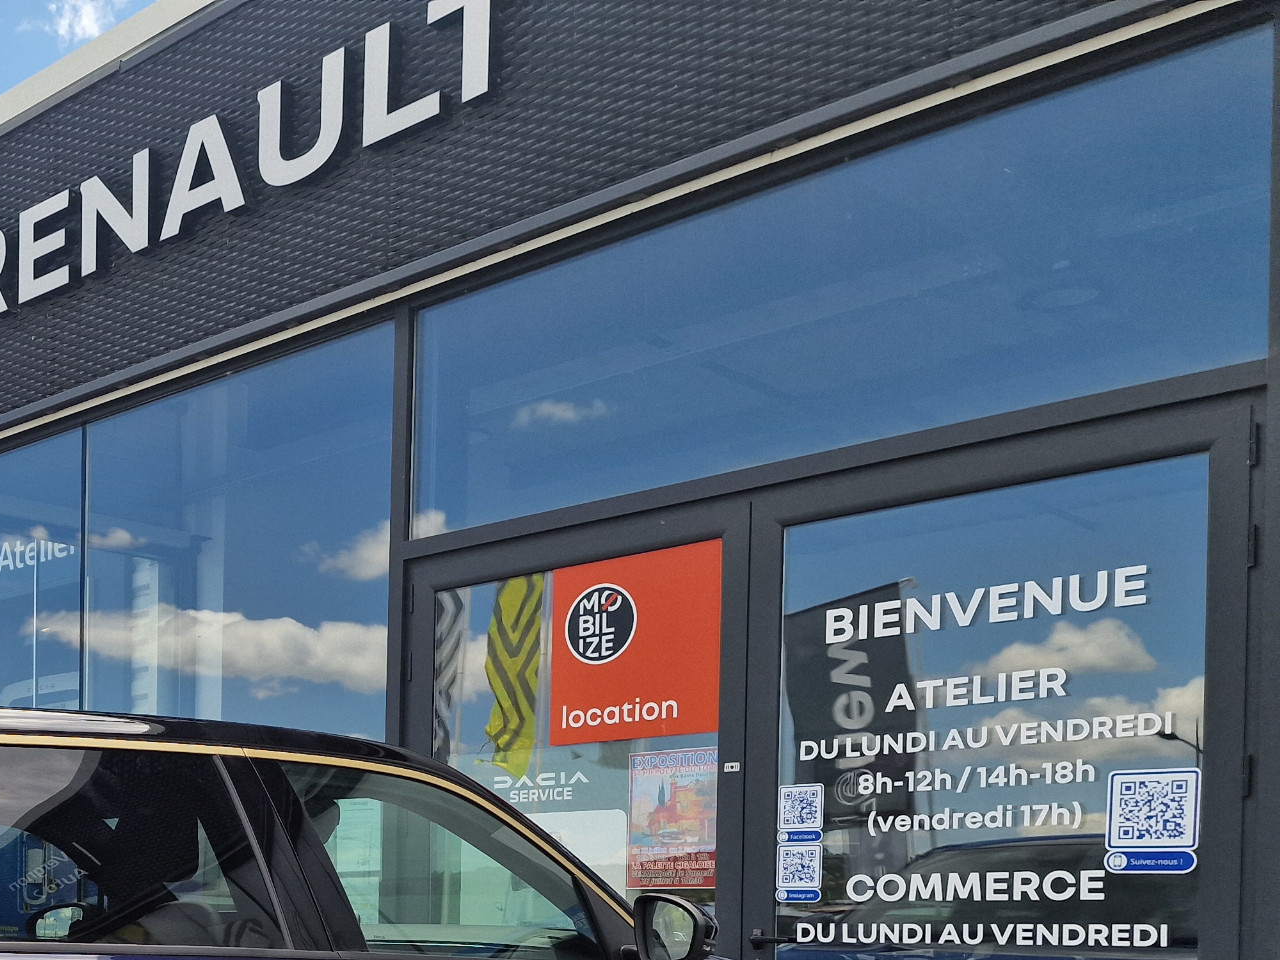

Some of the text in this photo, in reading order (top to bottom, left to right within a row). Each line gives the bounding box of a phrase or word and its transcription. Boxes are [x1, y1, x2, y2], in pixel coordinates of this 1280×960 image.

[825, 564, 1148, 645] BIENVENUE
[884, 667, 1067, 713] ATELIER
[561, 697, 678, 729] location
[799, 711, 1172, 761] DU LUNDI AU VENDREDI
[632, 751, 718, 770] EXPOSITION
[857, 767, 952, 795] 8h-12h
[976, 758, 1095, 788] 14h-18h
[493, 771, 590, 789] DACIA
[509, 787, 573, 803] SERVICE
[867, 801, 1082, 837] (vendredi 17h)
[1130, 858, 1178, 866] Suivez-nous
[846, 870, 1105, 902] COMMERCE
[796, 922, 1168, 948] DU LUNDI AU VENDREDI
